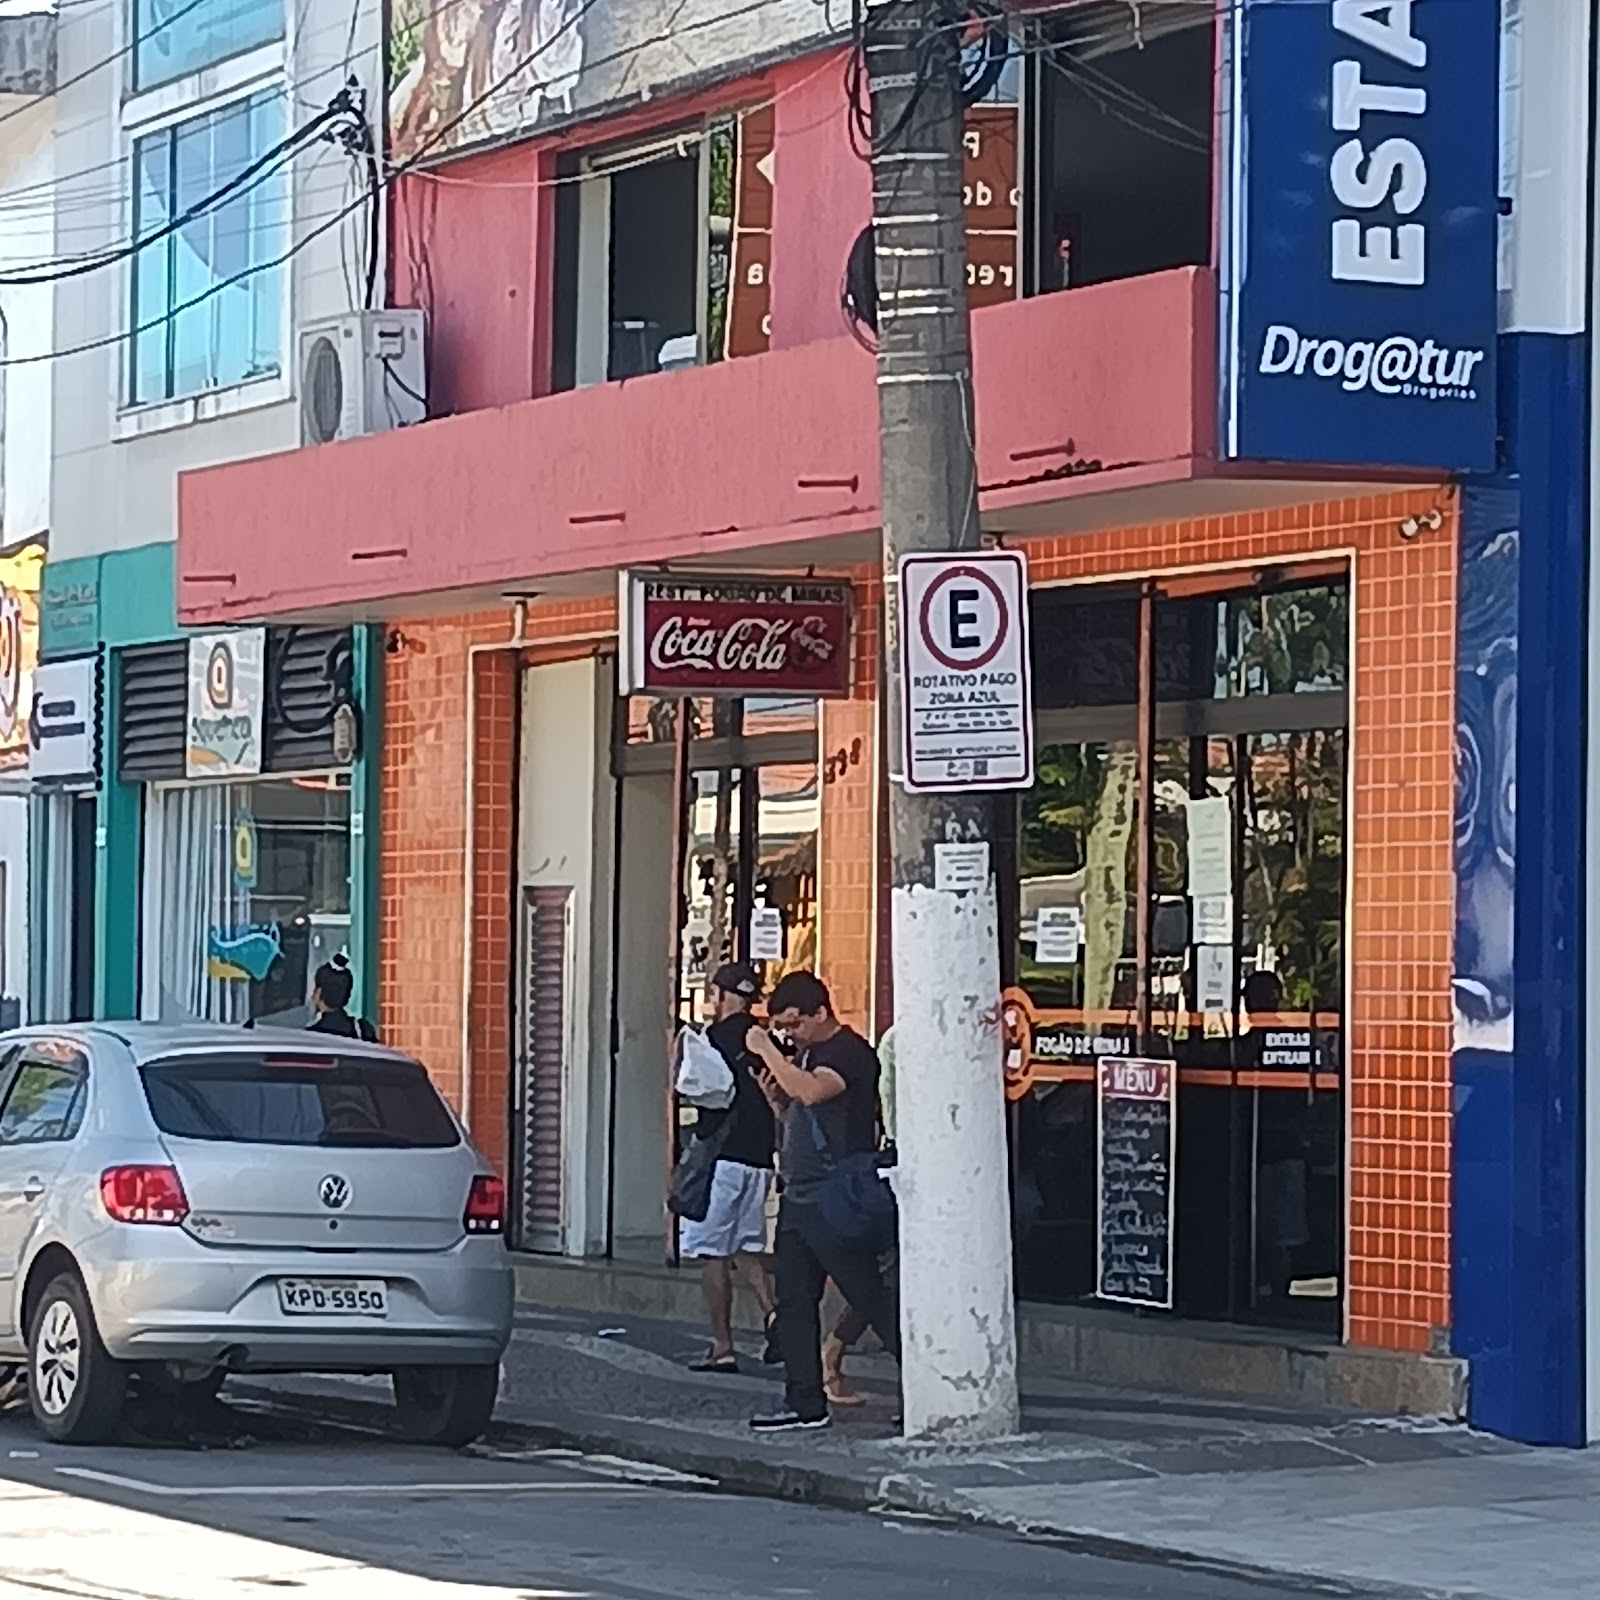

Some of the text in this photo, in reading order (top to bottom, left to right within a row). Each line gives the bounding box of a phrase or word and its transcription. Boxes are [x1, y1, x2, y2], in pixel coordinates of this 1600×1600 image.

[1259, 324, 1484, 394] Drog@tur
[949, 589, 981, 649] E
[914, 672, 1017, 689] ROTATIVO PAGO
